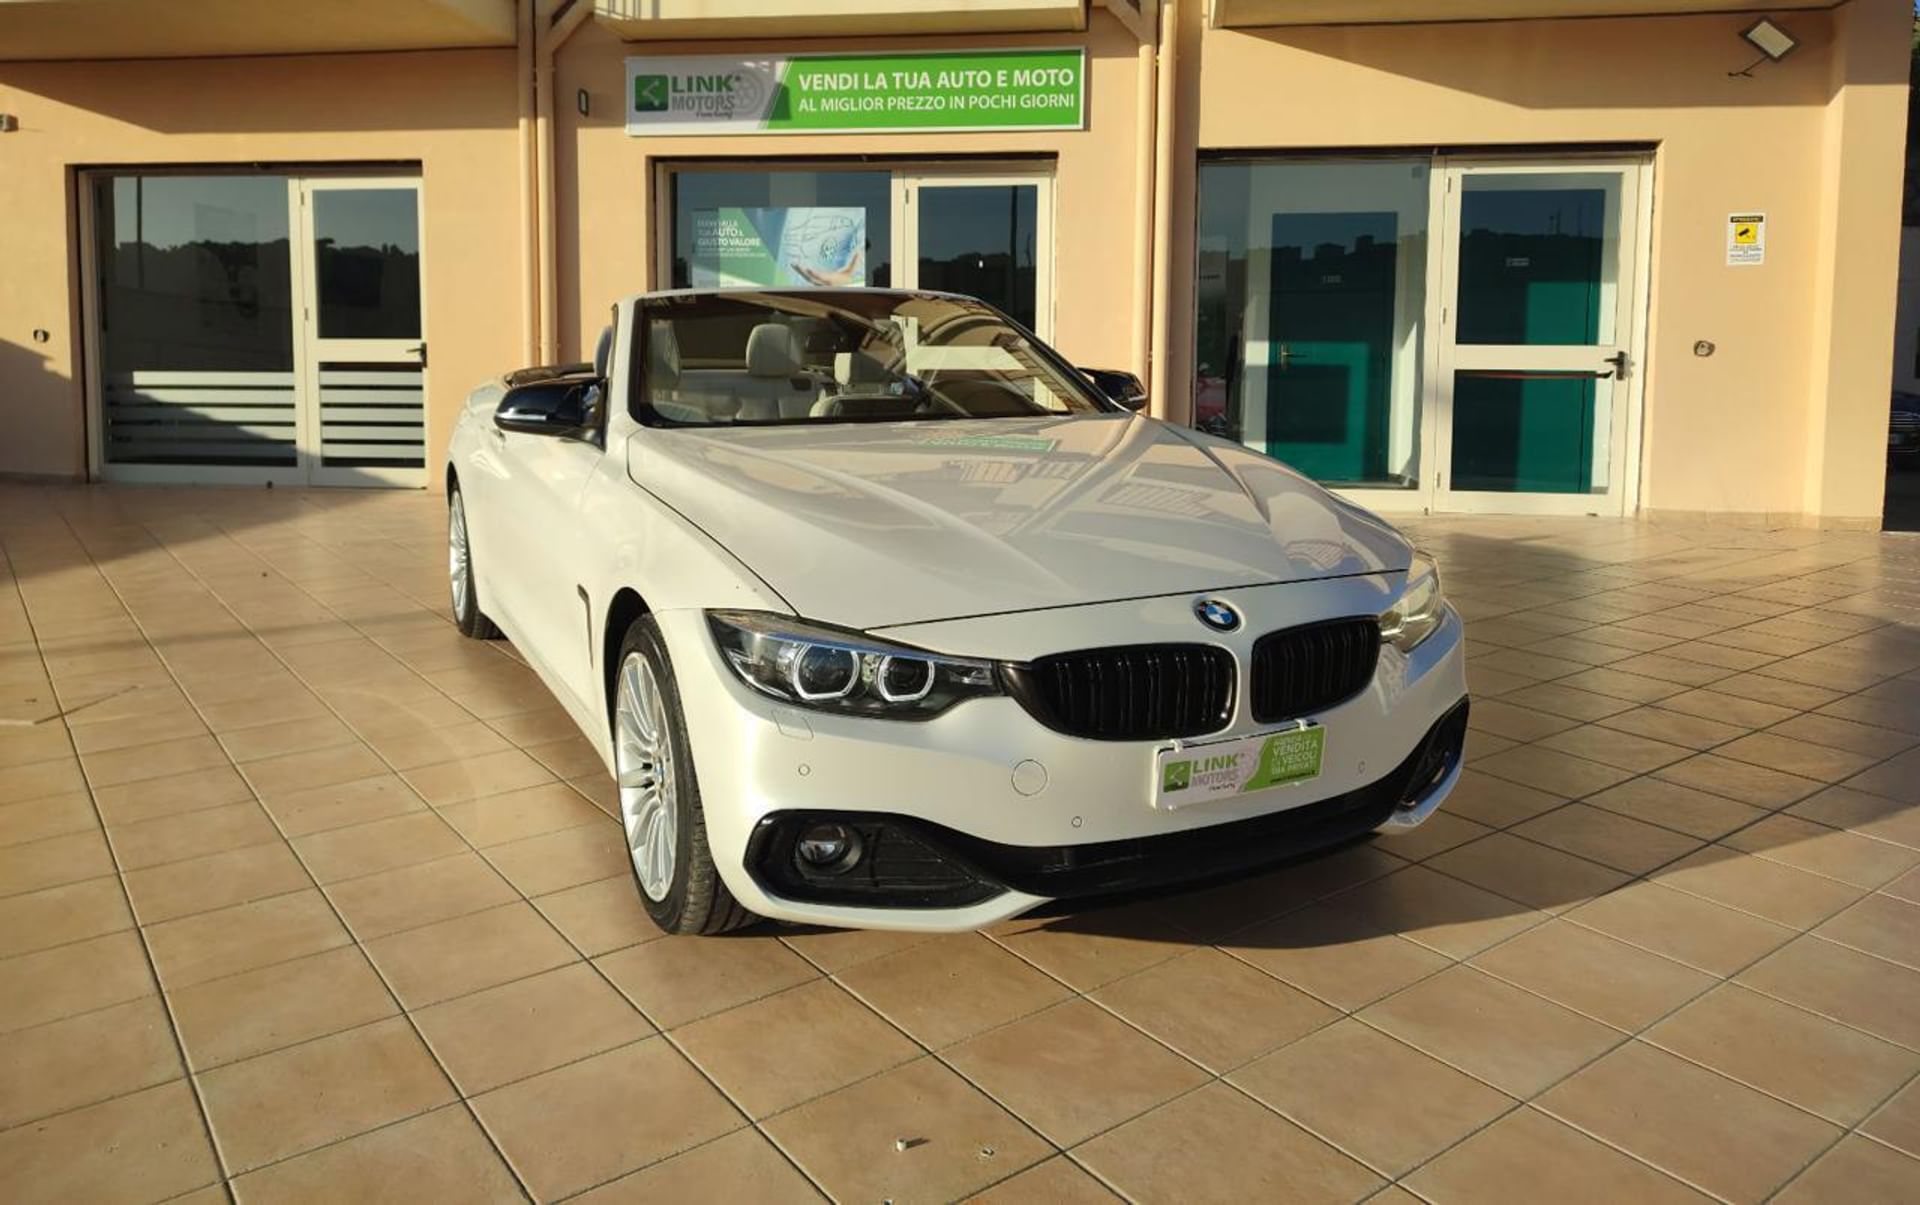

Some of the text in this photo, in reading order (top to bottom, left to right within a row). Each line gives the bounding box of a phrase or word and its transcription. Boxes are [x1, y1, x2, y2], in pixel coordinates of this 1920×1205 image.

[672, 75, 734, 92] LINK
[798, 68, 1074, 91] VENDI LA TUA AUTO E MOTO
[672, 94, 736, 111] MOTORS
[798, 93, 1074, 112] AL MIGLIOR PREZZO IN POCHI GIORNI
[712, 227, 738, 237] AUTO
[1272, 740, 1319, 760] VENDITA
[1193, 752, 1239, 774] LINK
